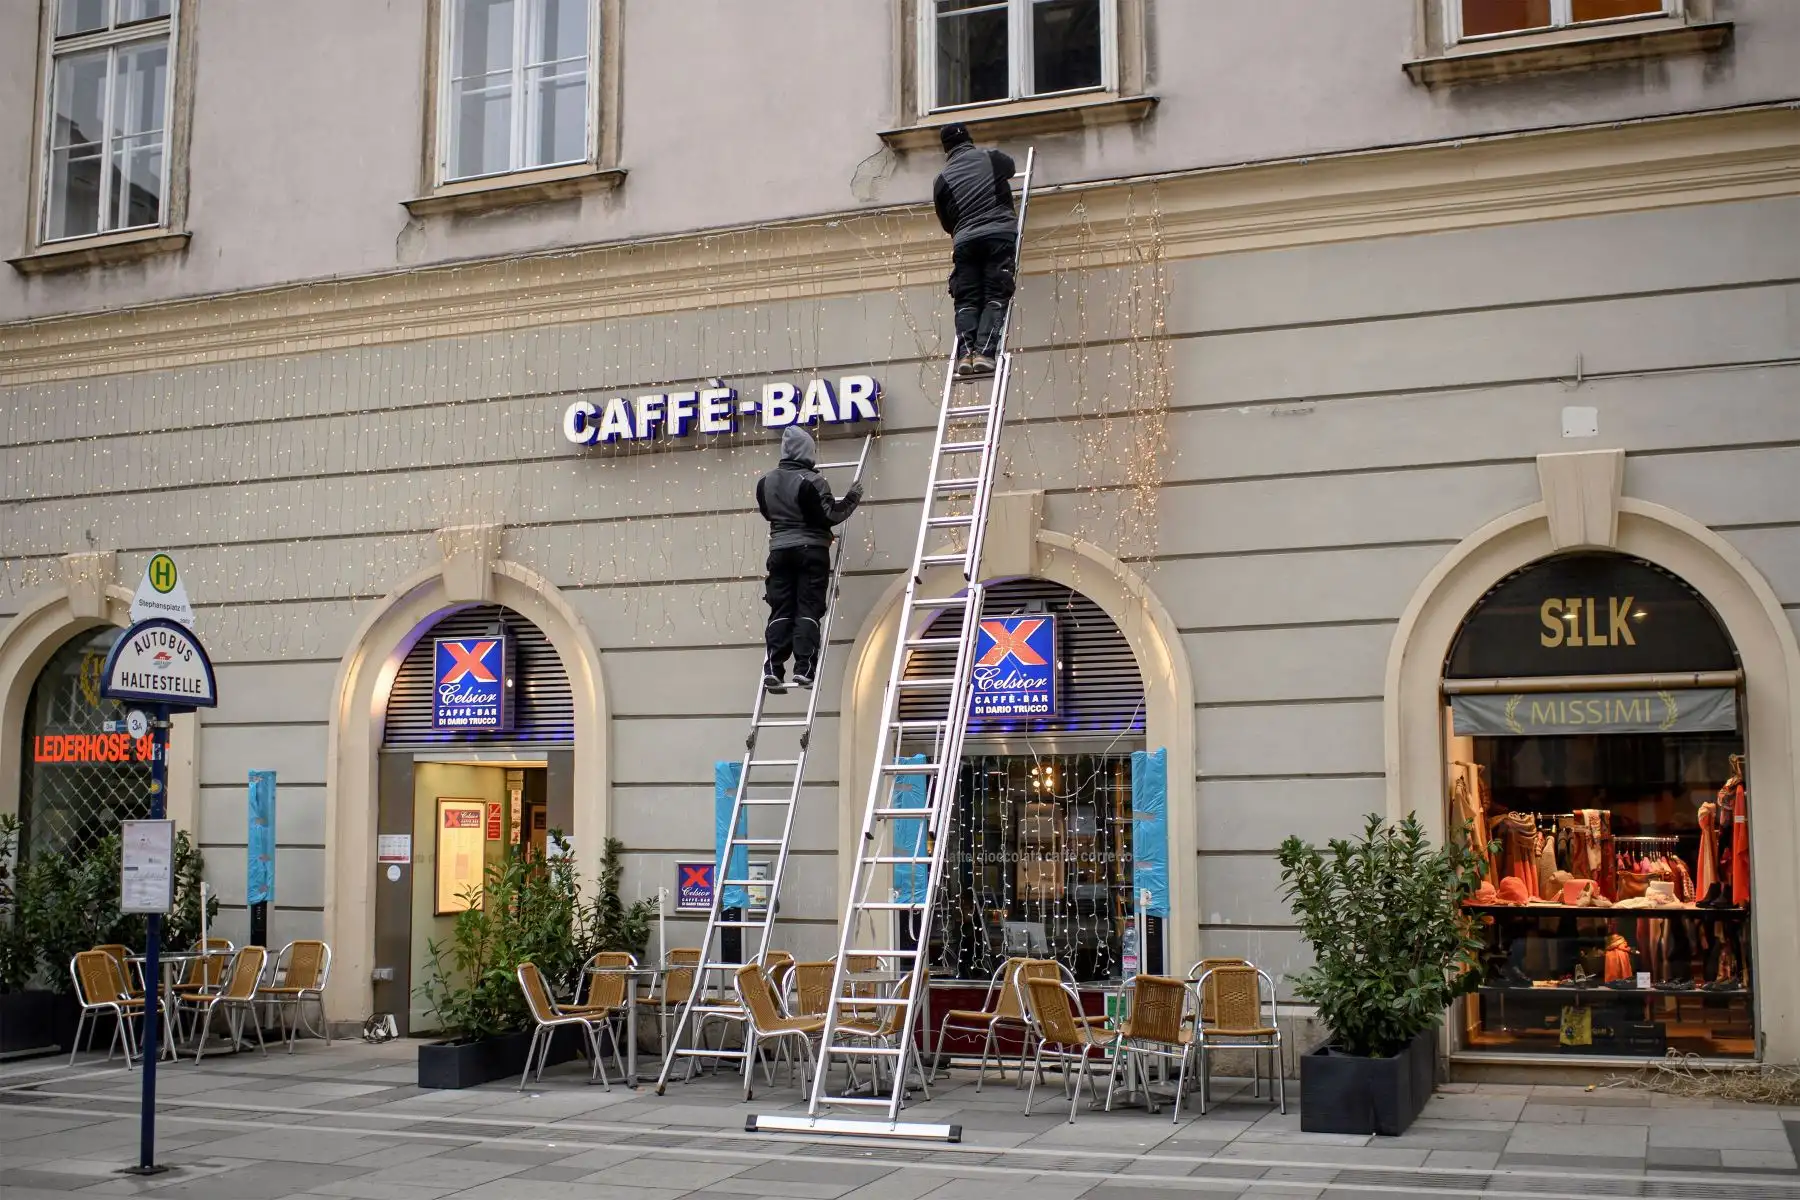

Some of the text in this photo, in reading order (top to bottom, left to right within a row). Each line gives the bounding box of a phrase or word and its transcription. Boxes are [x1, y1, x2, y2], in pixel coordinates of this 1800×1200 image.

[563, 375, 879, 444] CAFFÈ-BAR
[156, 561, 170, 586] H
[138, 599, 181, 612] Stephansplatz
[1540, 596, 1636, 648] SILK
[134, 631, 193, 662] AUTOBUS
[121, 671, 202, 694] HALTESTELLE
[973, 667, 1048, 691] Celsior
[438, 683, 497, 705] Celsior
[974, 694, 1048, 704] CAFFÈ-BAR
[438, 707, 497, 717] CAFFÈ-BAR
[975, 704, 1048, 714] DI DARIO TRUCCO
[1531, 698, 1651, 726] MISSIMI
[132, 719, 143, 731] 3A
[469, 717, 497, 725] TRUCCO
[34, 733, 130, 762] LEDERHOSE
